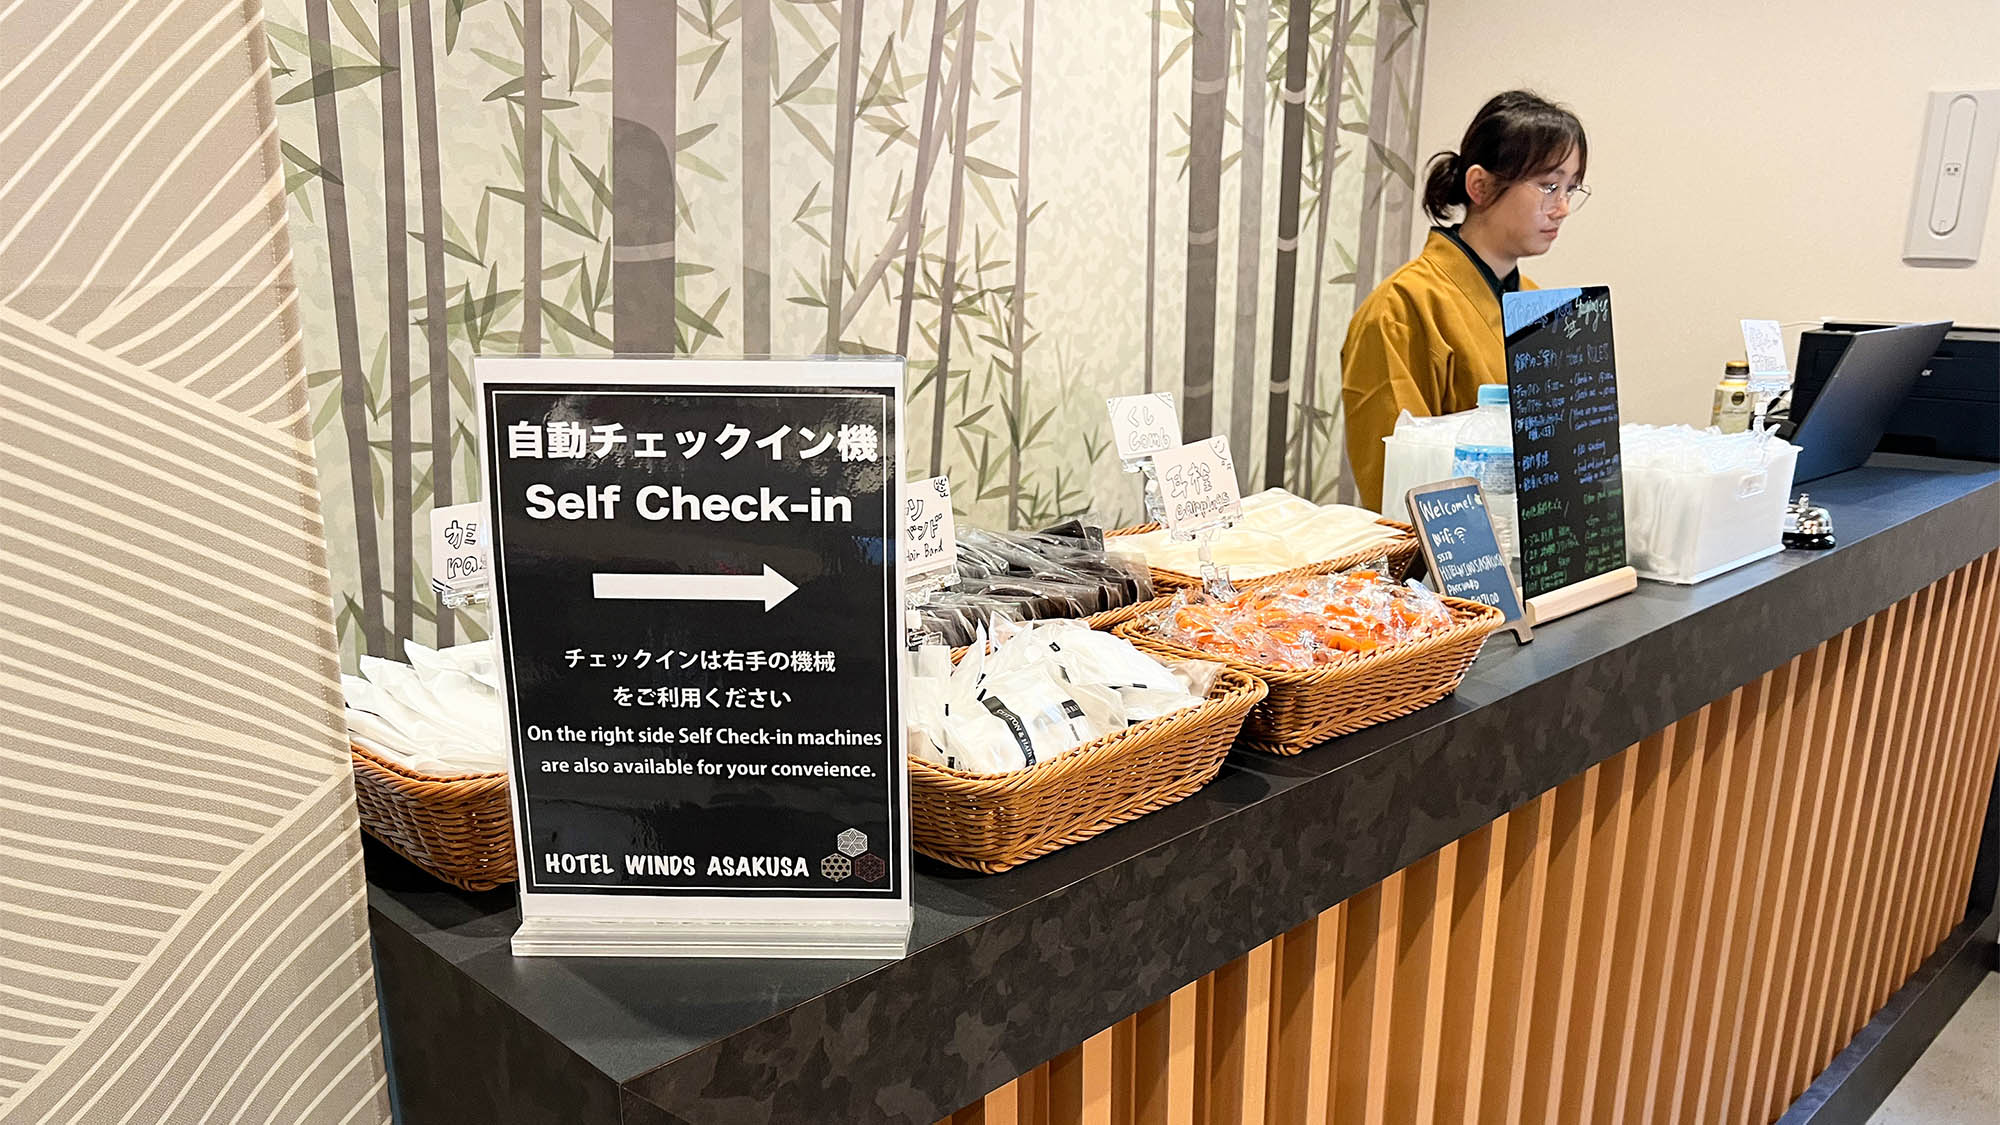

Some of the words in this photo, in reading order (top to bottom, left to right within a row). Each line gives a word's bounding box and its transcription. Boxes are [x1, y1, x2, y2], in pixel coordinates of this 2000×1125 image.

[507, 419, 880, 463] 自動チェックイン機
[525, 484, 621, 520] Self
[635, 485, 853, 523] Check-in
[1419, 493, 1476, 522] Welcome!
[564, 648, 837, 673] チェックインは右手の機械
[612, 686, 792, 709] をご利用ください
[527, 725, 553, 742] On
[556, 726, 587, 742] the
[590, 726, 635, 746] right
[638, 727, 675, 744] side
[678, 726, 713, 744] Self
[716, 727, 793, 746] Check-in
[797, 729, 883, 747] machines
[540, 760, 570, 774] are
[573, 757, 609, 774] also
[613, 758, 694, 776] available
[697, 758, 723, 776] for
[726, 763, 768, 780] your
[771, 762, 877, 778] conveience.
[545, 852, 615, 876] HOTEL
[624, 853, 696, 877] WINDS
[706, 854, 810, 878] ASAKUSA
